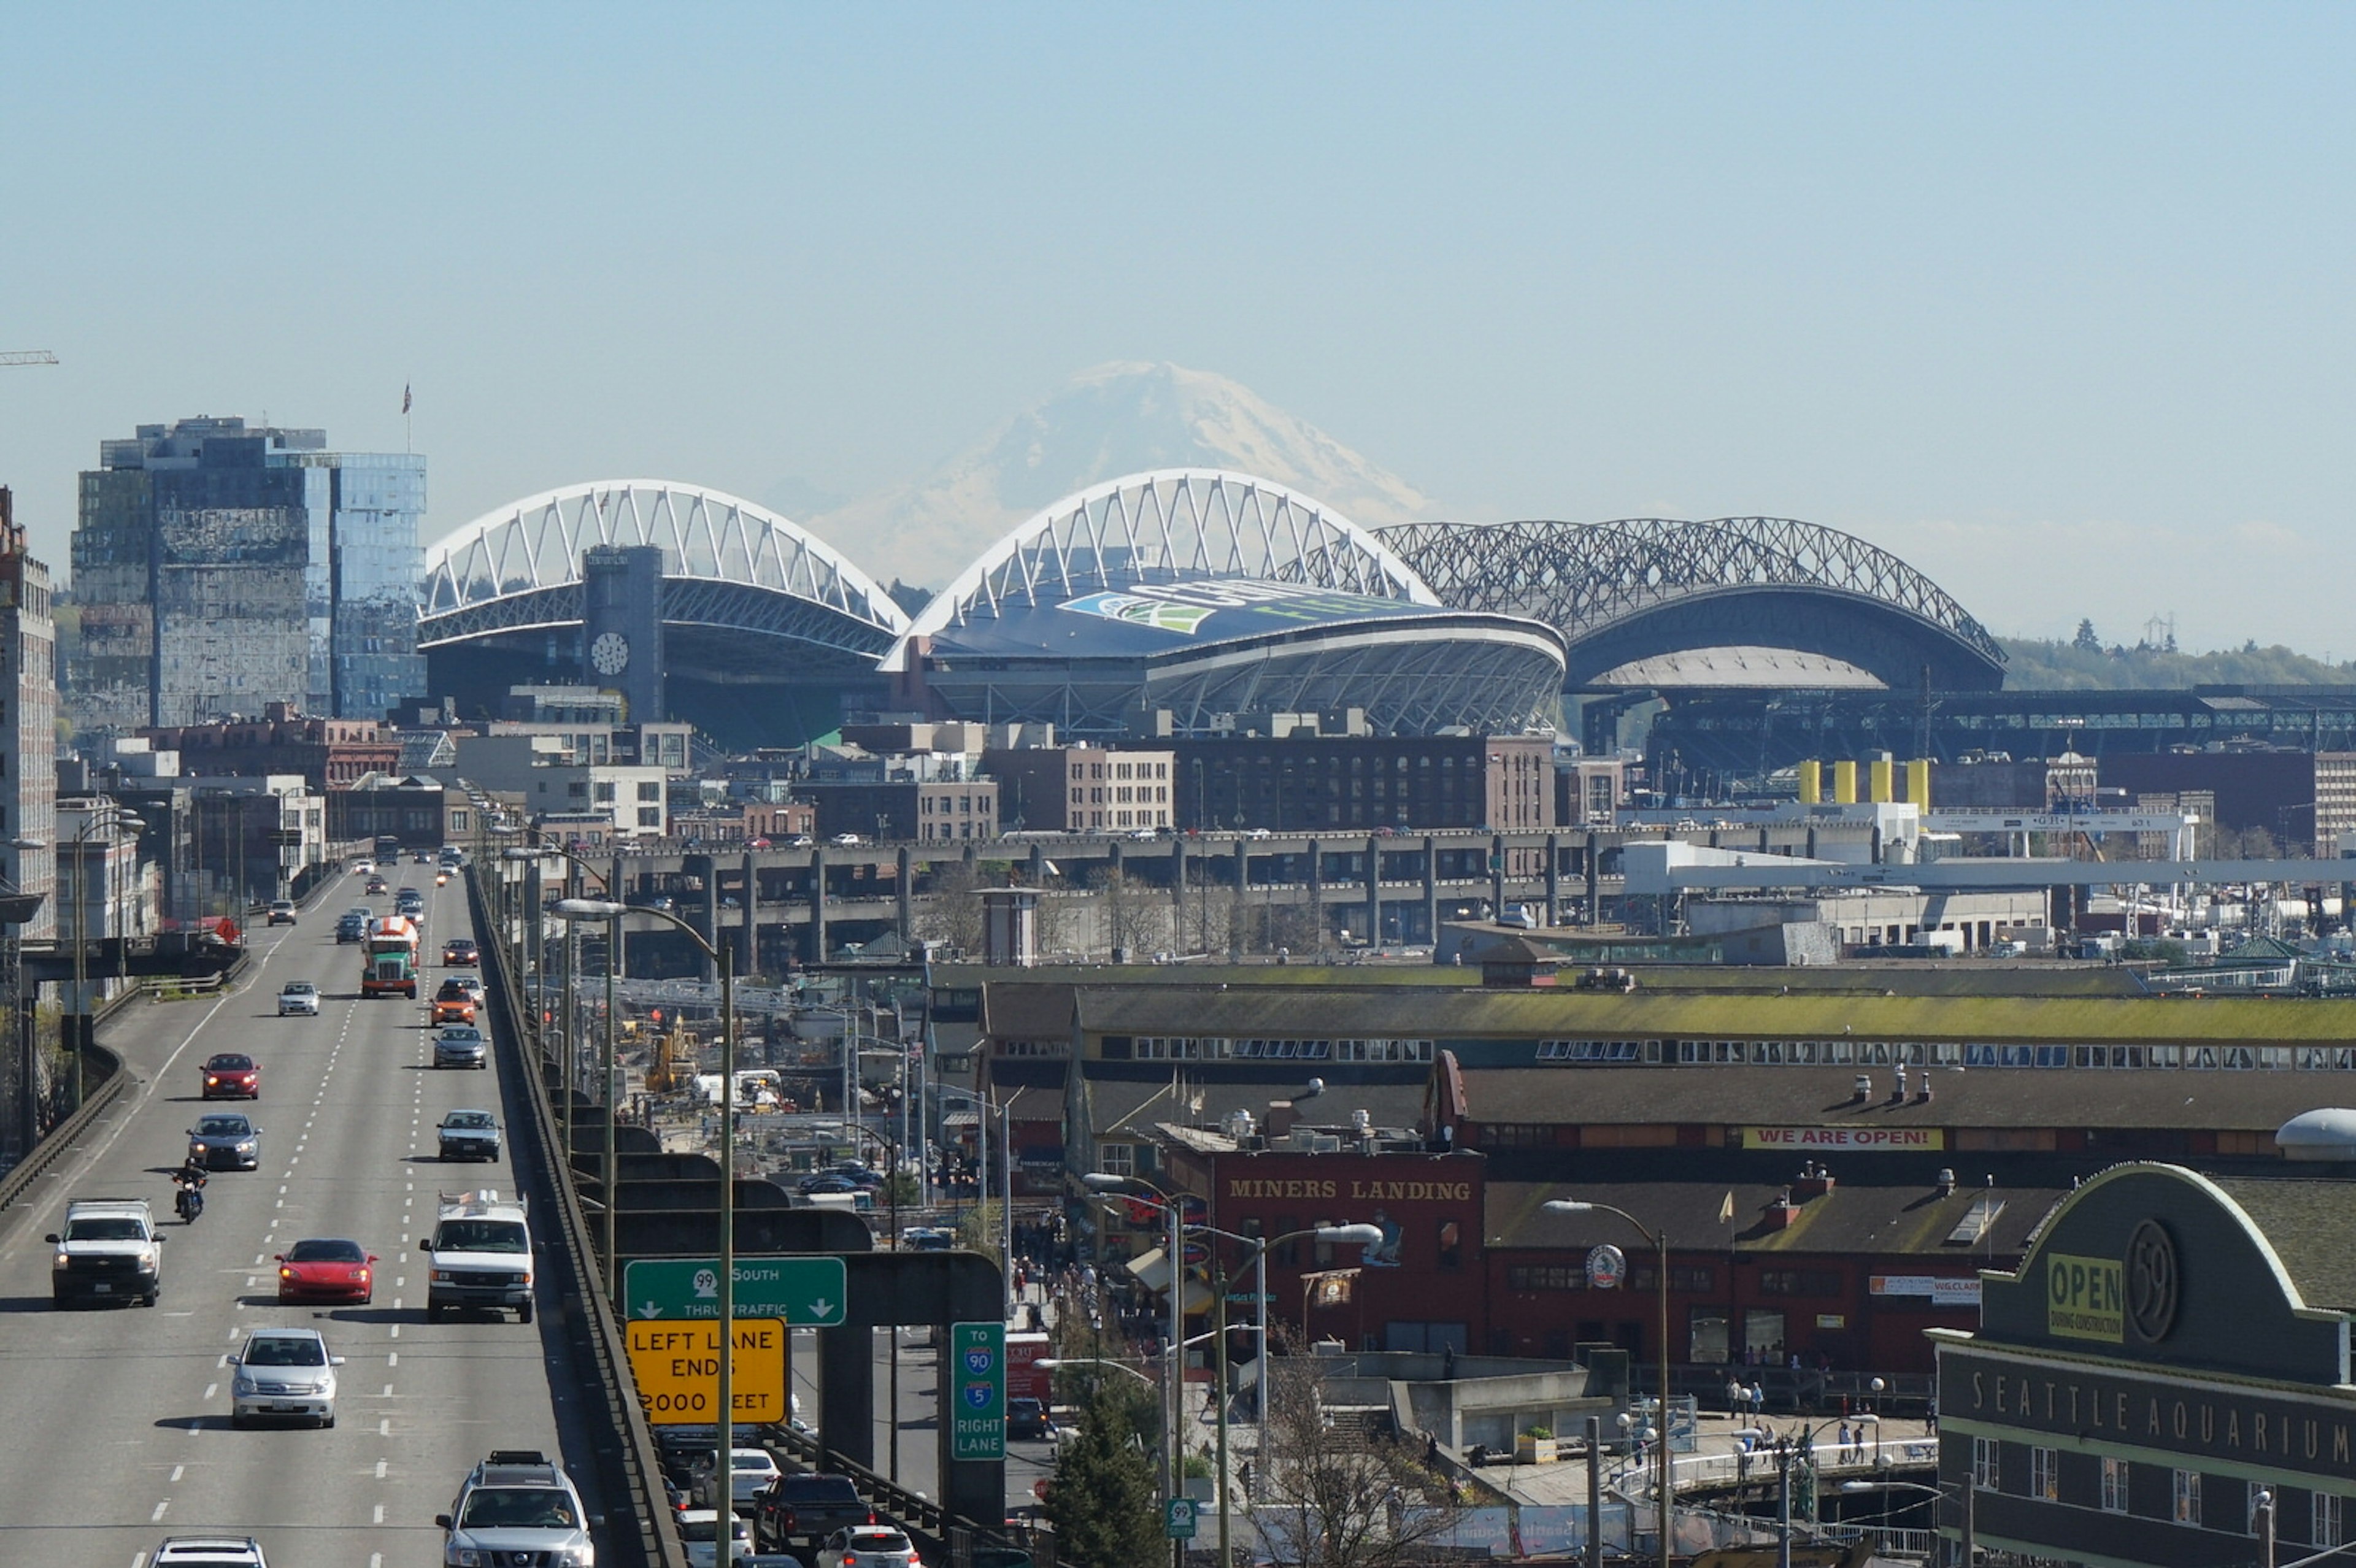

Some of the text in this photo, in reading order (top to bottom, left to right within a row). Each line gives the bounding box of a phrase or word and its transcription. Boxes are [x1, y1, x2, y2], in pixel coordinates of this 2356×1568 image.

[1758, 1130, 1928, 1144] WE ARE OPEN!
[1230, 1179, 1471, 1201] MINERS LANDING
[697, 1273, 713, 1288] 99
[2051, 1261, 2121, 1313] OPEN
[2135, 1242, 2166, 1318] 59
[684, 1304, 788, 1316] THRU TRAFFIC
[2051, 1310, 2121, 1335] DURING CONSTRUCTION
[634, 1332, 695, 1351] LEFT
[970, 1330, 988, 1342] TO
[969, 1355, 988, 1368] 90
[640, 1393, 769, 1412] 2000 EET
[974, 1389, 984, 1403] 5
[1973, 1370, 2350, 1463] SEATTLE AQUARIUM
[957, 1419, 1001, 1433] RIGHT
[958, 1437, 999, 1452] LANE
[1174, 1506, 1187, 1518] 99
